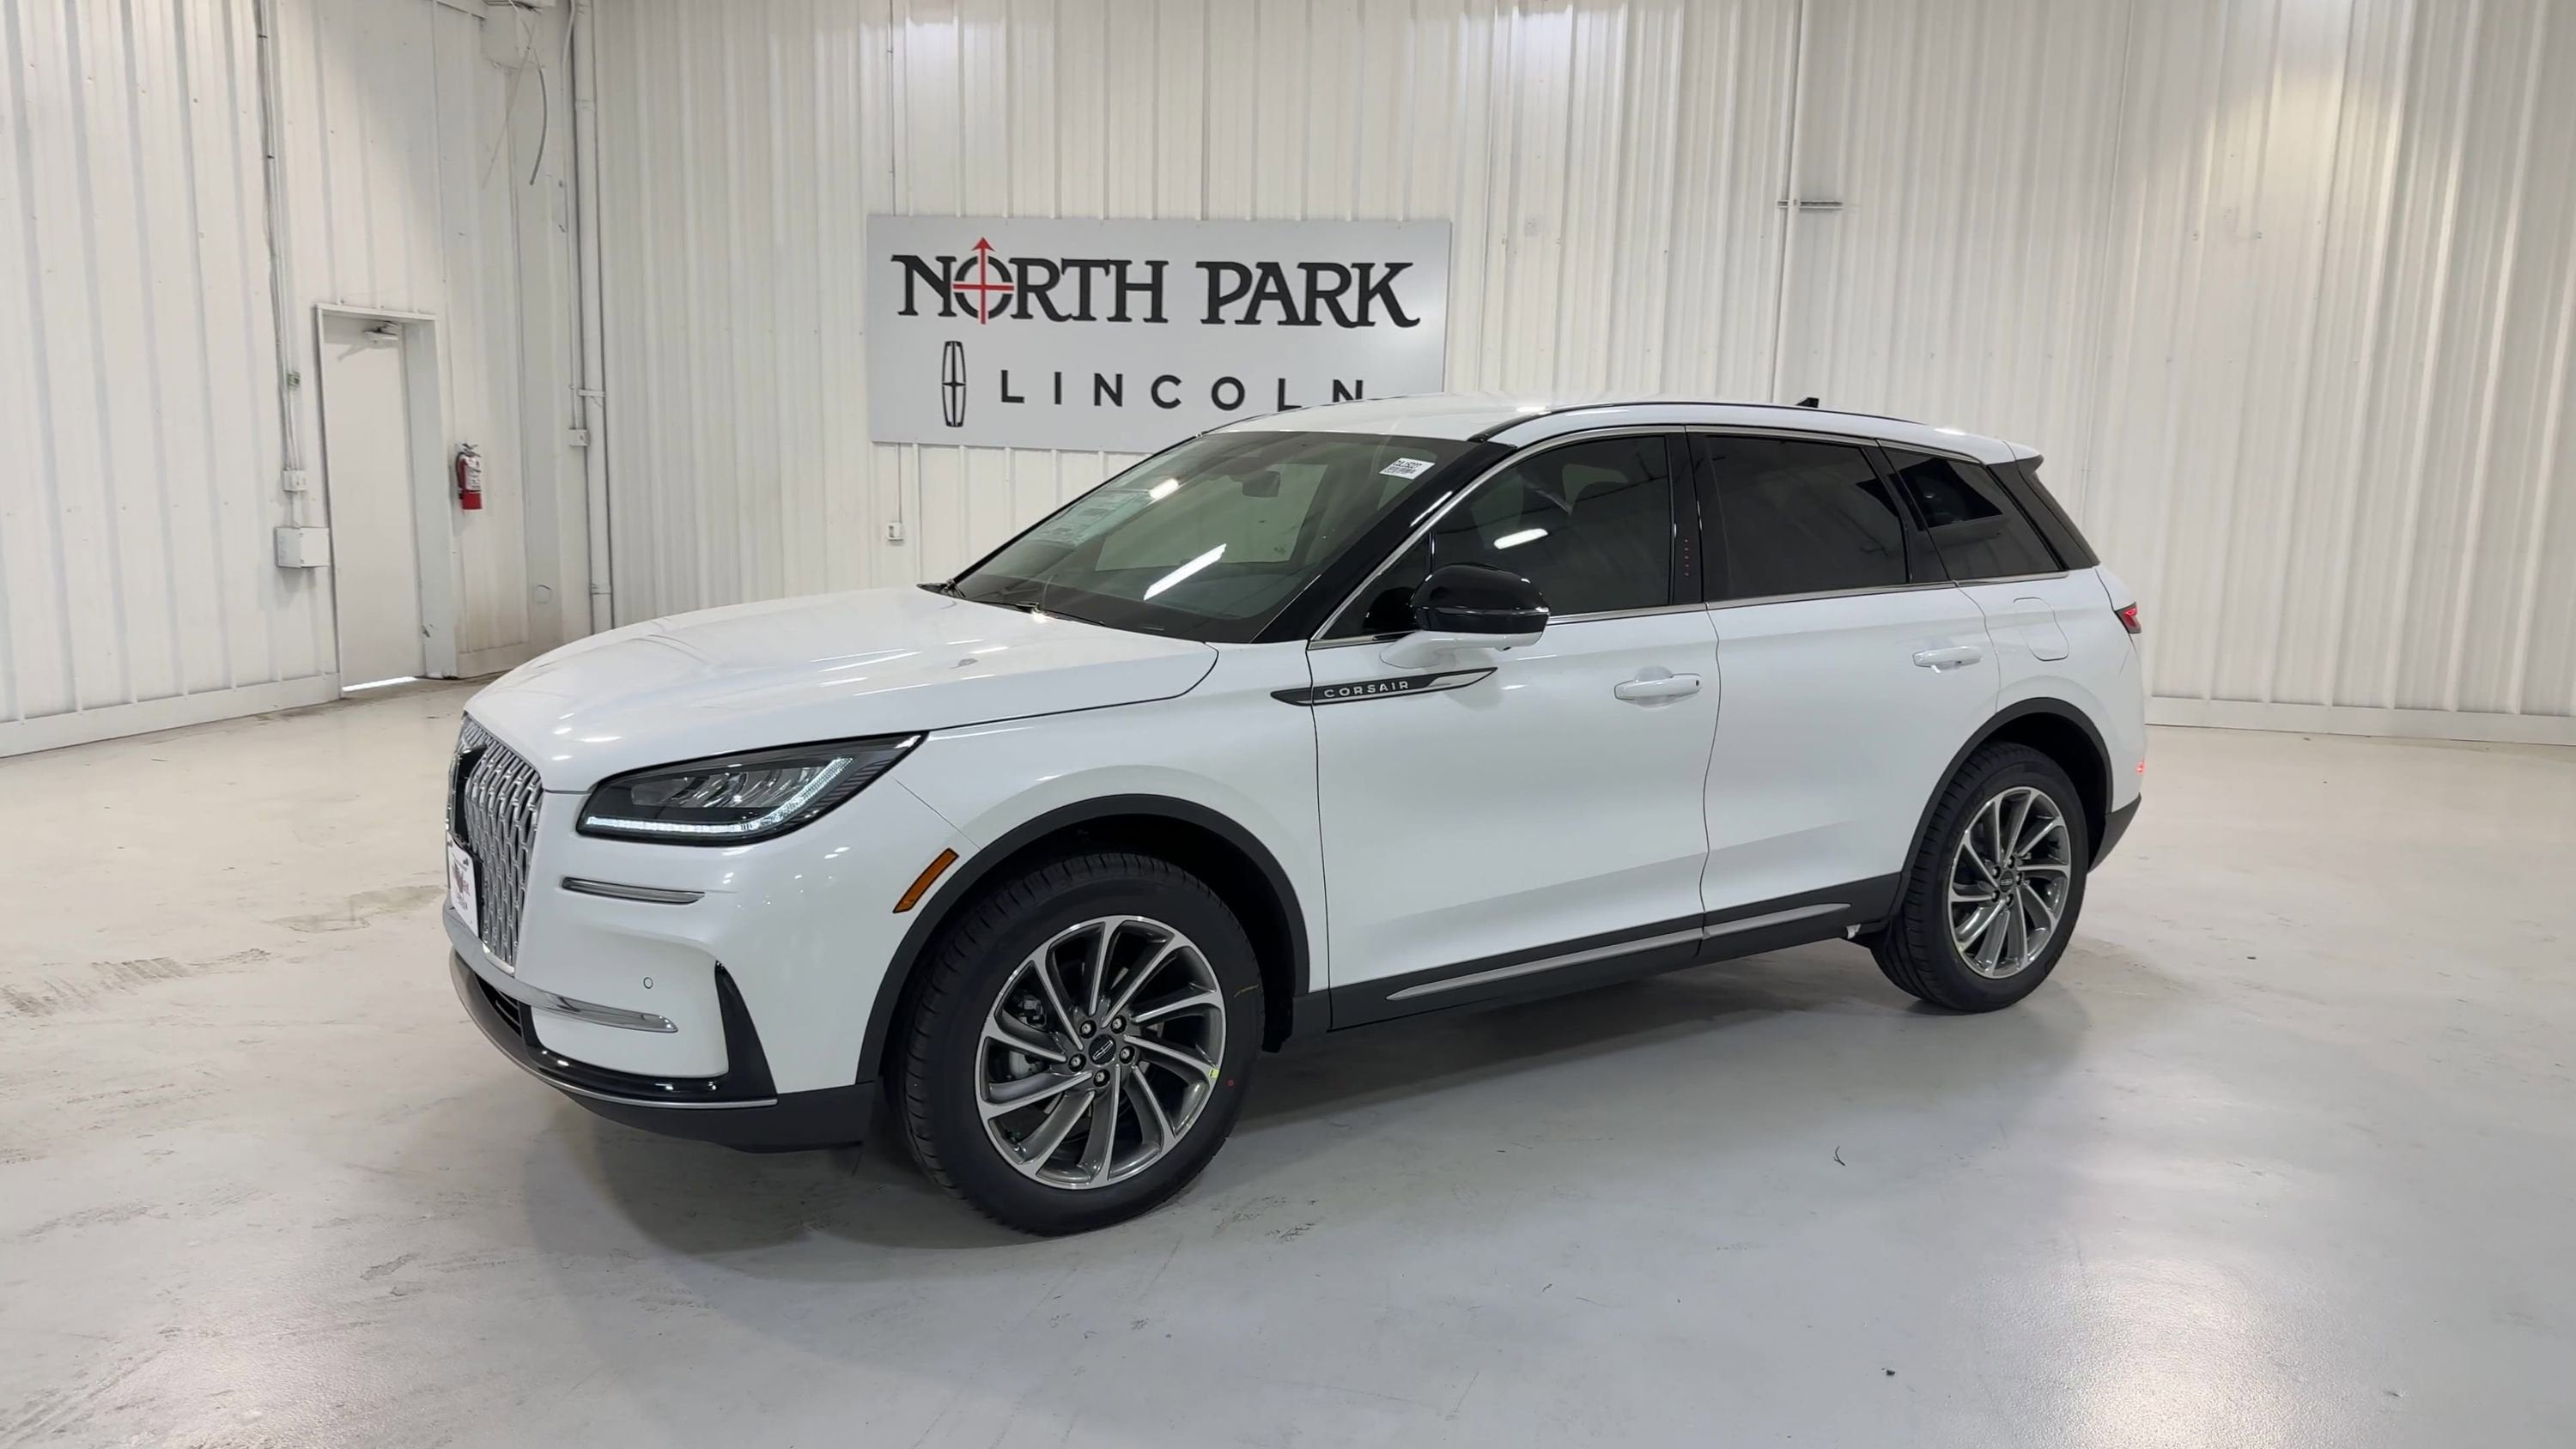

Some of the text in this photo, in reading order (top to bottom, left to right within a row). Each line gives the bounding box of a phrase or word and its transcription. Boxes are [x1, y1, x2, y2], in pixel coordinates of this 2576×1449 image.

[890, 254, 1421, 329] NORTH PARK
[1000, 369, 1364, 411] LINCOLN
[1323, 680, 1409, 698] CORSAIR
